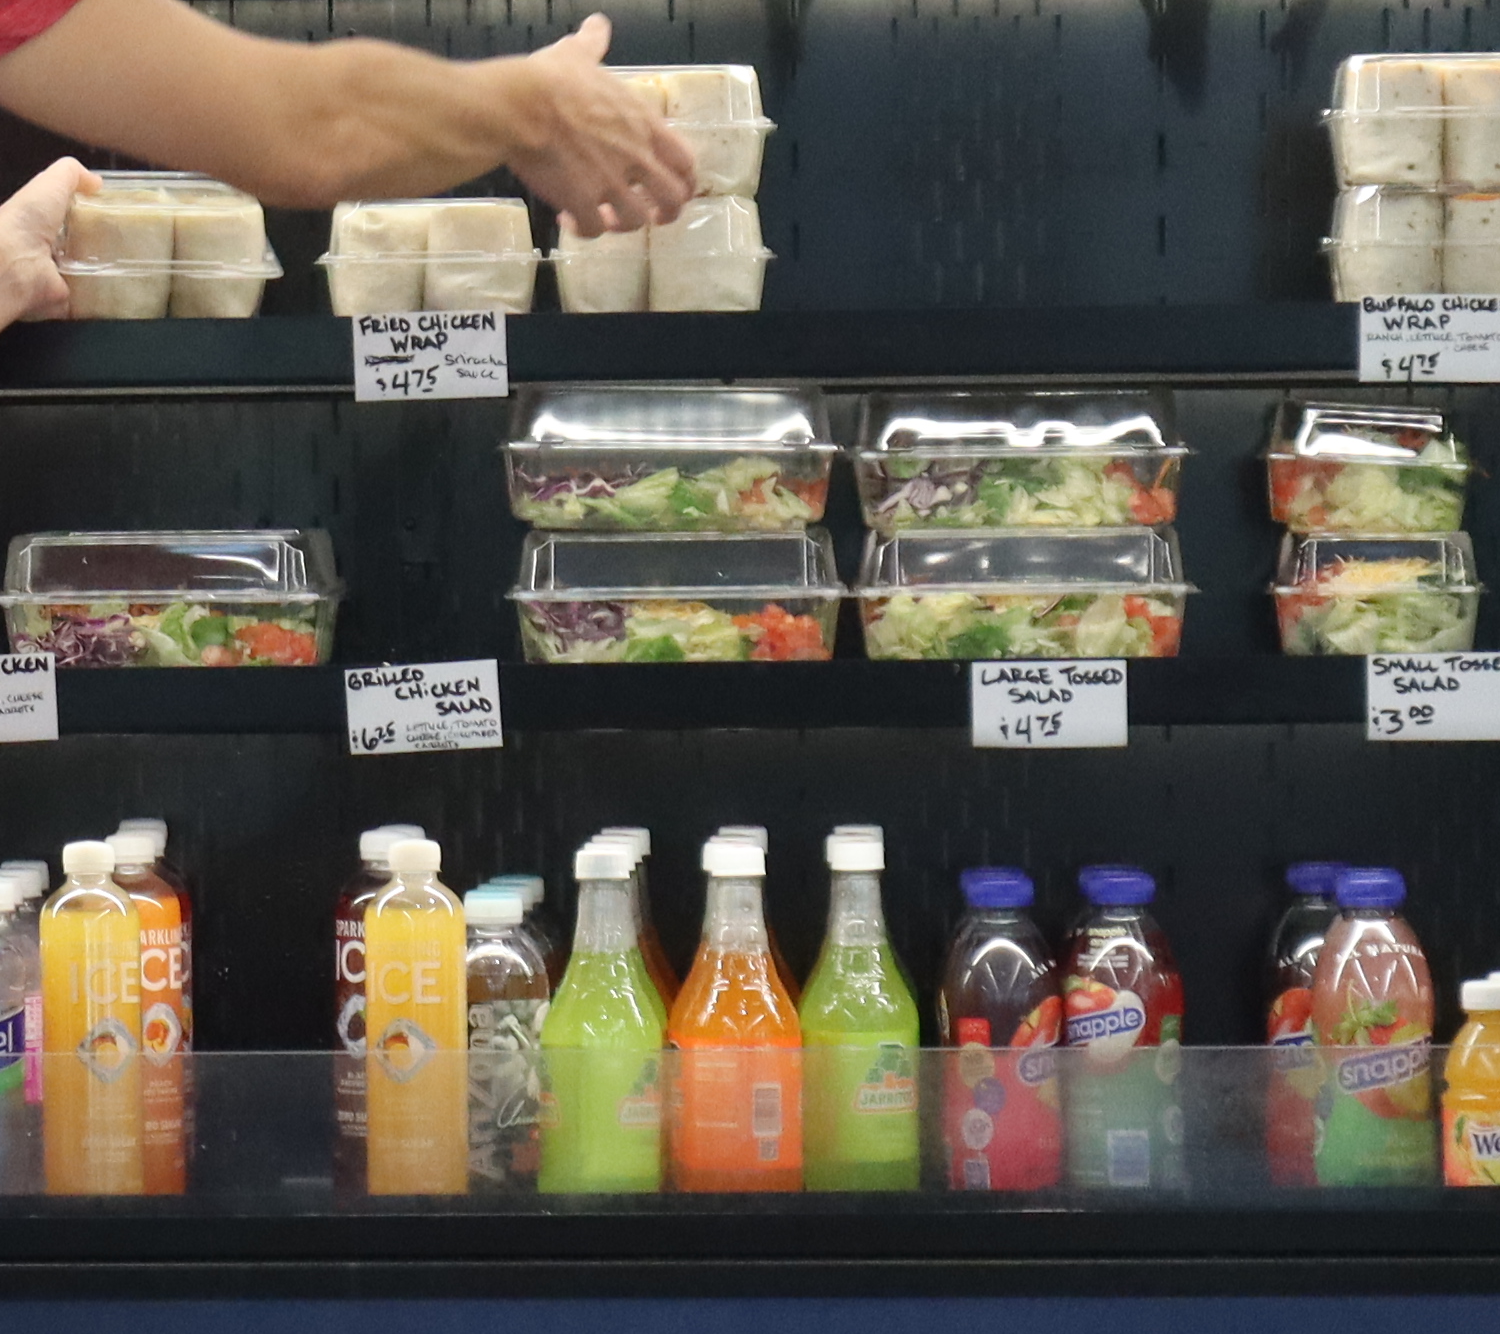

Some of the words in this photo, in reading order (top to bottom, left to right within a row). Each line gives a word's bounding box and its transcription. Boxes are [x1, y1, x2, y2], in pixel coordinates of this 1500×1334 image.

[1363, 296, 1435, 313] BUFFALO
[359, 314, 411, 336] FRIED
[418, 311, 496, 332] CHICKEN
[1383, 315, 1452, 331] WRAP
[390, 332, 449, 354] WRAP
[981, 667, 1053, 686] LARGE
[1058, 666, 1124, 686] TOSSED
[1372, 657, 1439, 676] SMALL
[347, 666, 425, 691] GRILLED
[395, 676, 481, 701] CHICKEN
[1393, 676, 1461, 694] SALAD
[1008, 687, 1074, 704] SALAD
[435, 697, 493, 717] SALAD
[336, 920, 365, 938] SPARK
[140, 946, 183, 992] CE
[335, 939, 367, 984] IC
[68, 961, 141, 1005] ICE
[367, 960, 442, 1006] ICE
